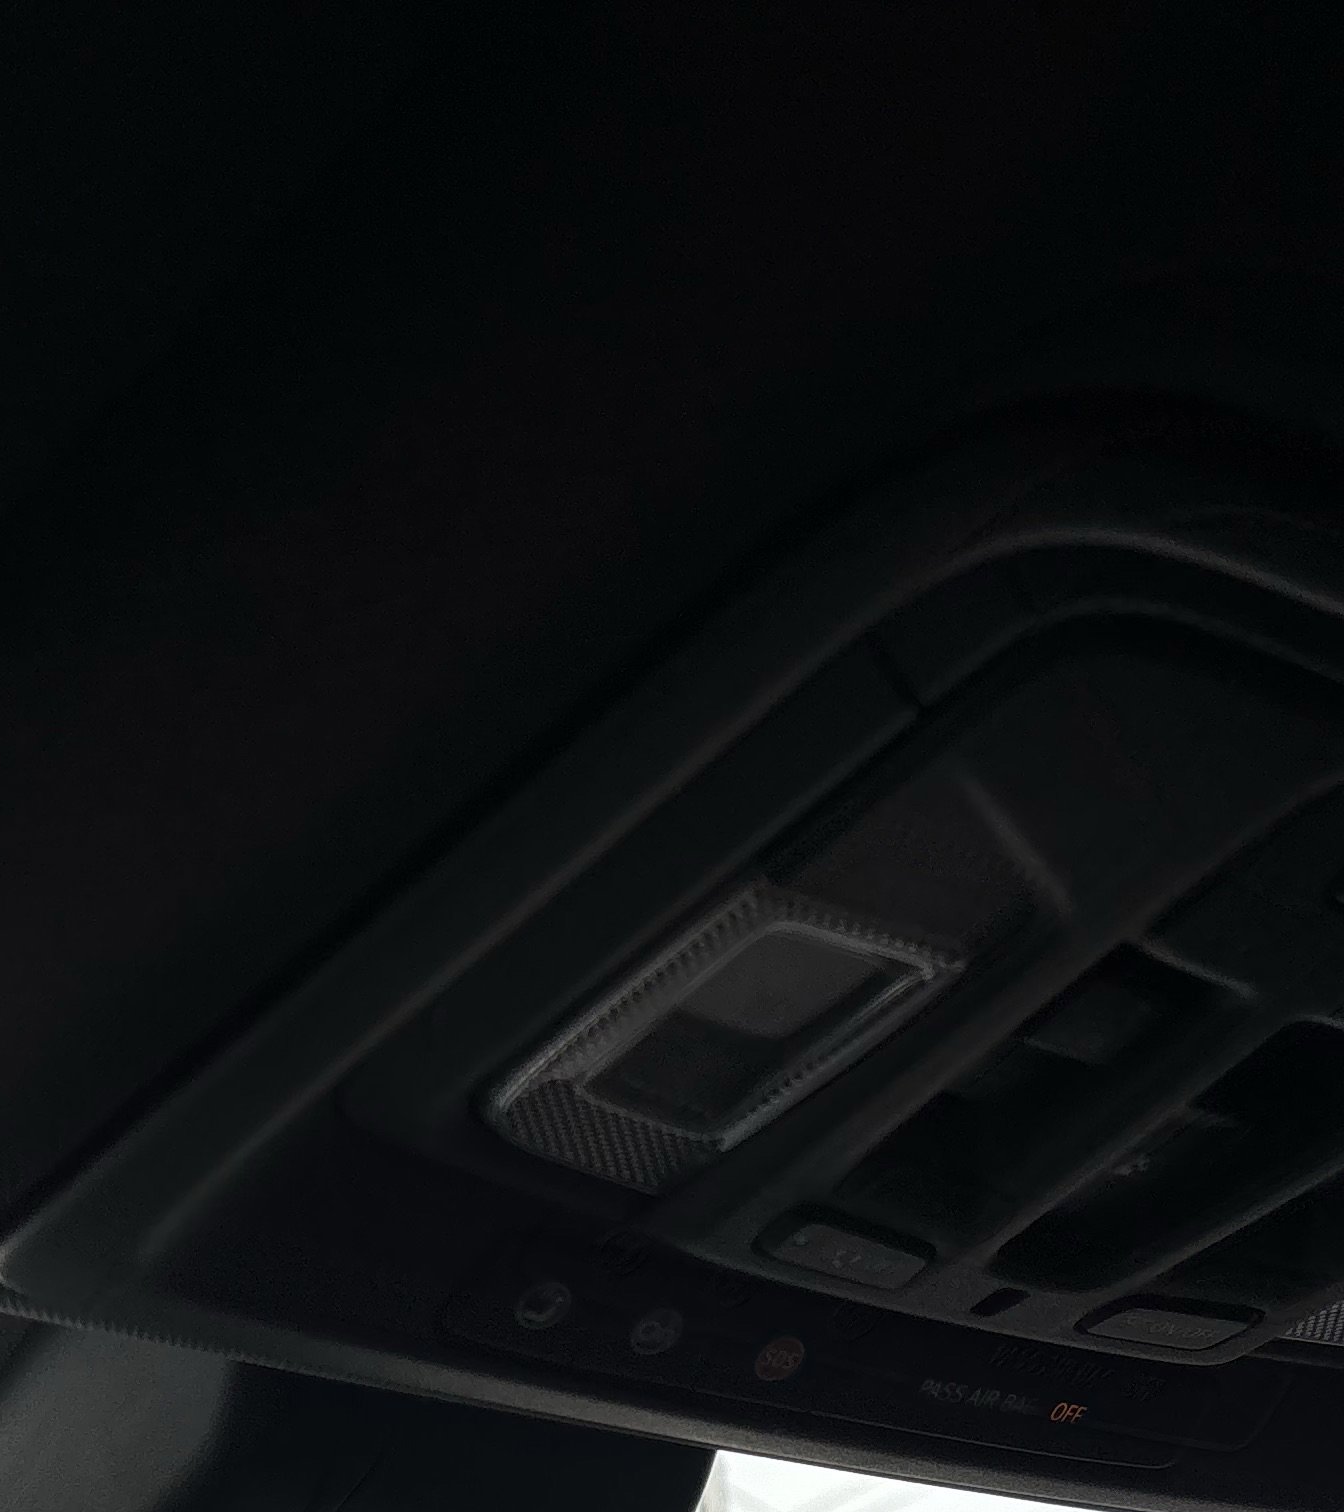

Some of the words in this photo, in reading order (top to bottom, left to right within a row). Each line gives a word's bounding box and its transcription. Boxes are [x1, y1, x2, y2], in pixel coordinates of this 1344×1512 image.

[761, 1348, 799, 1371] SOS
[919, 1378, 964, 1403] PASS
[969, 1387, 998, 1408] AIR
[1048, 1400, 1088, 1424] OFF
